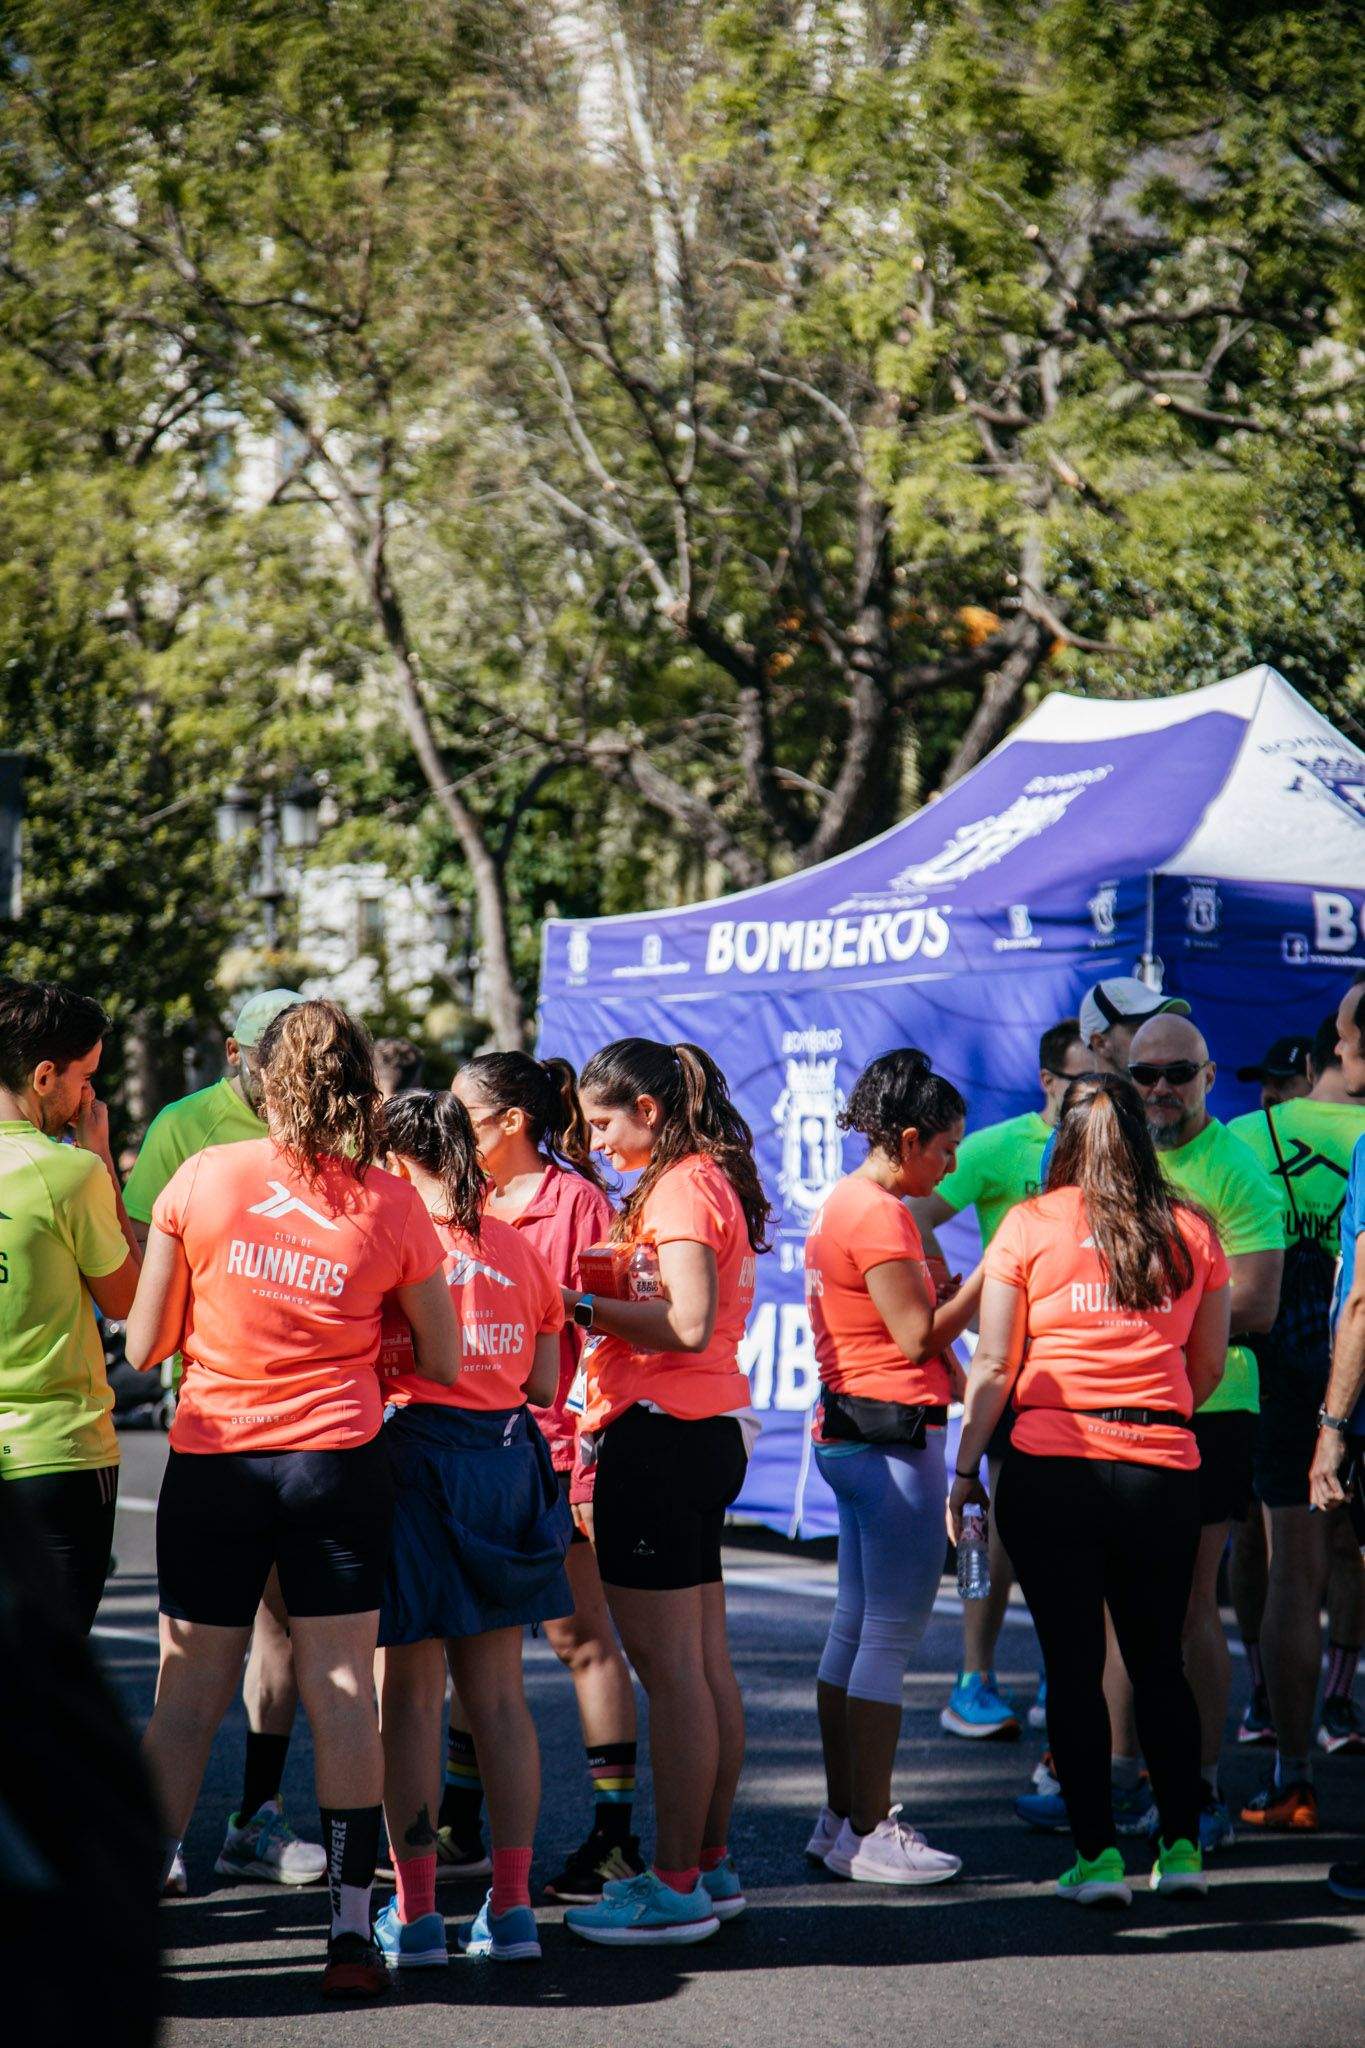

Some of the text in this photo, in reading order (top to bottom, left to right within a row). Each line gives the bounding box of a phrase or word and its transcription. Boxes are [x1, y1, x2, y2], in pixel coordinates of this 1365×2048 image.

[704, 905, 952, 975] BOMBEROS
[782, 1028, 843, 1054] BOMBEROS
[275, 1232, 297, 1245] CLUB
[227, 1239, 348, 1297] RUNNERS
[462, 1323, 526, 1357] NNERS
